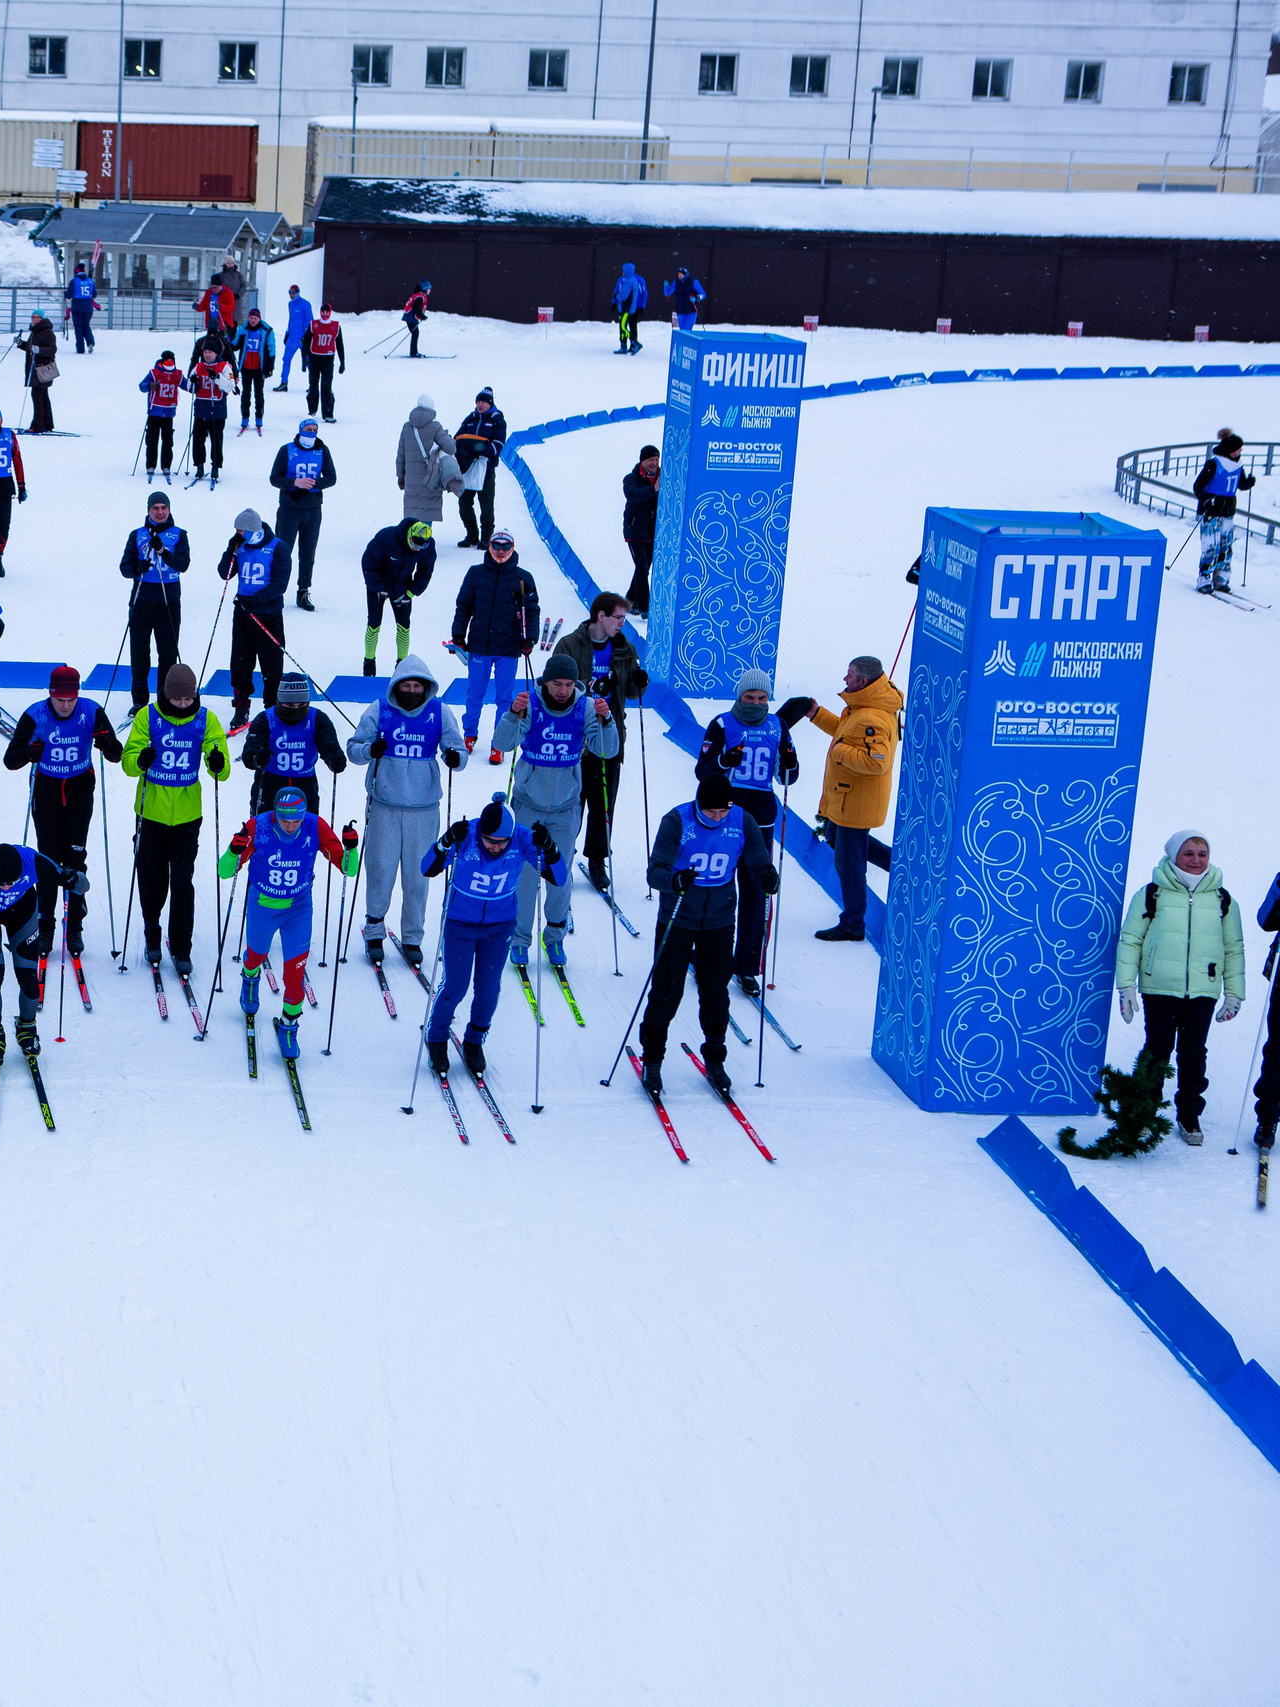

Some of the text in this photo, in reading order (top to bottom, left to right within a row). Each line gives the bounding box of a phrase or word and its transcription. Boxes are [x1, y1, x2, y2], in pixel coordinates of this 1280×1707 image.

[101, 129, 113, 178] TRITON
[80, 286, 90, 297] 15
[318, 334, 332, 347] 107
[702, 351, 803, 388] ФИНИШ
[160, 383, 176, 398] 123
[742, 405, 796, 418] МОСКОВСКАЯ
[741, 417, 772, 428] ЛЫЖНЯ
[708, 441, 782, 451] ЮГО-ВОСТОК
[1226, 475, 1239, 493] 17
[241, 561, 265, 585] 42
[990, 554, 1152, 621] СТАРТ
[1053, 641, 1143, 660] МОСКОВСКАЯ
[1051, 661, 1102, 679] ЛЫЖНЯ
[996, 700, 1120, 716] ЮГО-ВОСТОК
[61, 736, 80, 745] МОЭК
[174, 740, 193, 749] МОЭК
[288, 741, 306, 749] МОЭК
[50, 746, 79, 762] 96
[161, 750, 190, 770] 94
[276, 752, 305, 771] 95
[734, 746, 770, 781] 36
[147, 768, 177, 781] ЛЫЖНЯ
[281, 860, 301, 868] МОЭК
[268, 869, 298, 887] 89
[469, 871, 509, 894] 27
[40, 1102, 54, 1128] FISCHER
[442, 1088, 466, 1136] BRADOS
[480, 1088, 508, 1135] BRADOS
